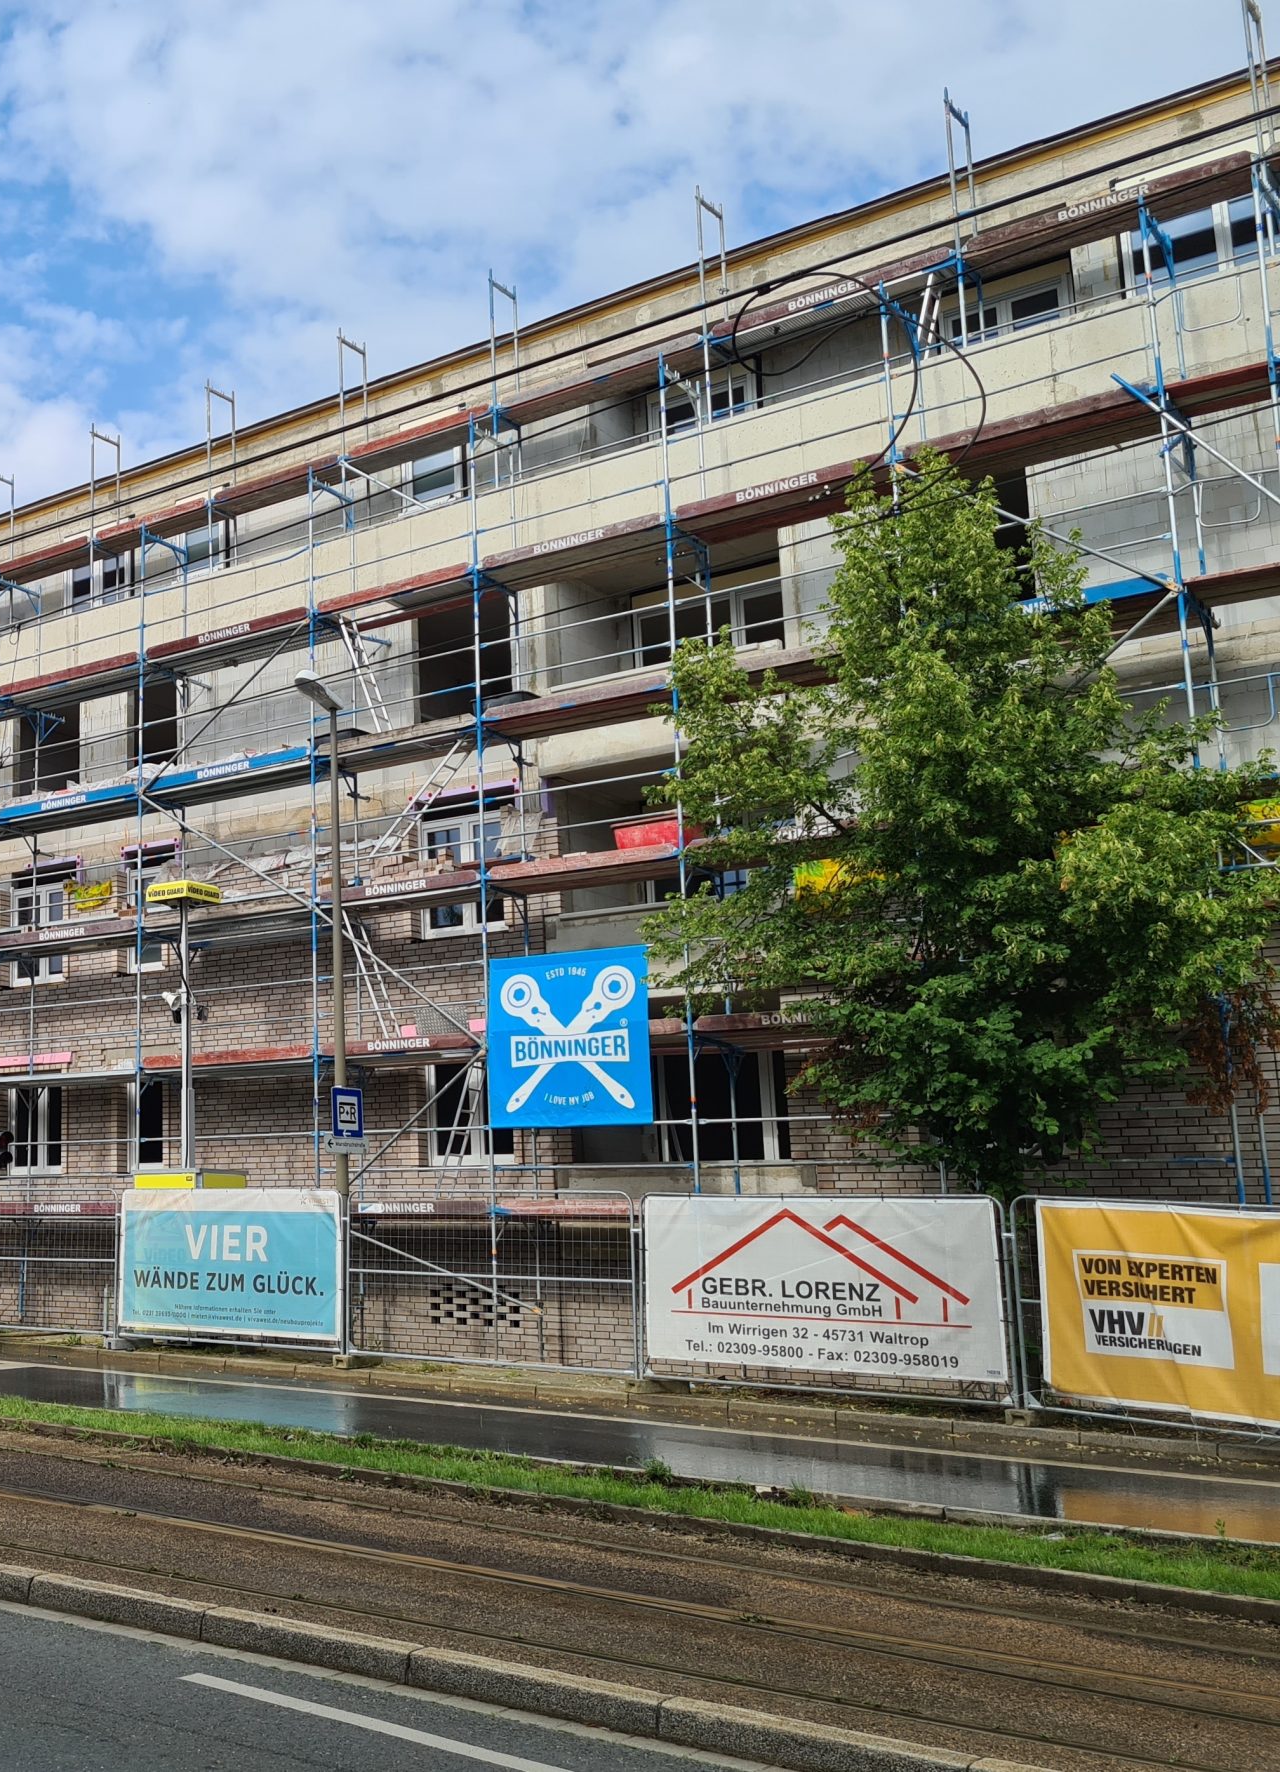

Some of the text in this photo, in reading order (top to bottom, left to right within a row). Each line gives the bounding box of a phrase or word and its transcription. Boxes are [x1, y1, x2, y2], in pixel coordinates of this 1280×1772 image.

[1057, 183, 1150, 222] BÖNNINGER
[787, 278, 865, 312] BÖNNINGER
[735, 472, 818, 503] BÖNNINGER
[197, 623, 251, 644] BÖNNINGER
[196, 760, 250, 780] BÖNNINGER
[40, 794, 87, 810] BÖNNINGER
[365, 879, 427, 897] BÖNNINGER
[38, 926, 85, 941] BÖNNINGER
[545, 966, 587, 981] ESTD 1945
[367, 1037, 430, 1051] BÖNNINGER
[514, 1034, 626, 1062] BÖNNINGER
[549, 1094, 567, 1106] LOVE
[569, 1096, 580, 1106] MY
[582, 1091, 595, 1103] JOB
[33, 1202, 81, 1213] BÖNNINGER
[185, 1224, 268, 1262] VIER
[134, 1266, 324, 1297] WÄNDE ZUM GLÜCK.
[1081, 1257, 1217, 1285] VON EXPERTEN
[701, 1276, 881, 1302] GEBR. LORENZ
[701, 1297, 883, 1318] Bauunternehmung GmbH
[708, 1322, 724, 1334] Im
[728, 1322, 788, 1340] Wirrigen
[792, 1327, 809, 1339] 32
[822, 1328, 864, 1343] 45731
[870, 1331, 930, 1348] Waltrop
[1088, 1309, 1145, 1336] VHV
[685, 1339, 713, 1353] Tel.:
[717, 1341, 804, 1359] 02309-95800
[817, 1347, 849, 1362] Fax:
[853, 1350, 960, 1369] 02309-958019
